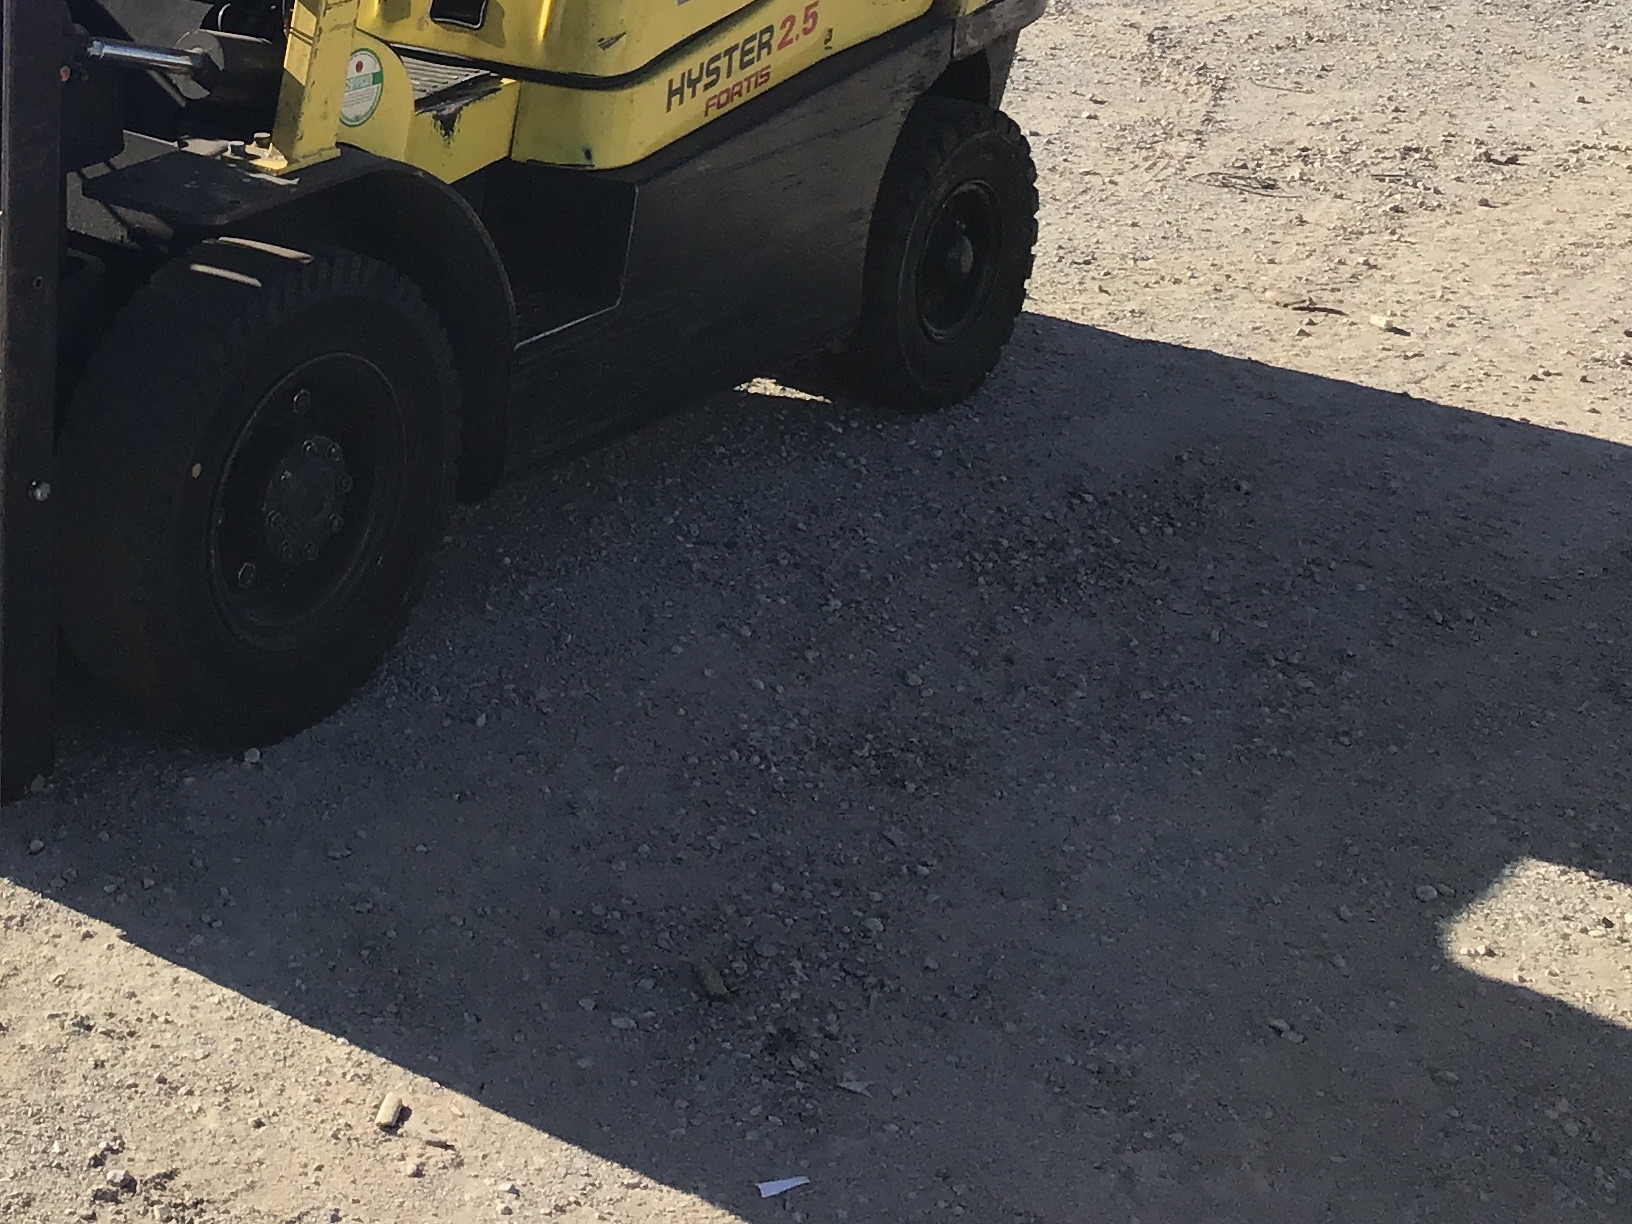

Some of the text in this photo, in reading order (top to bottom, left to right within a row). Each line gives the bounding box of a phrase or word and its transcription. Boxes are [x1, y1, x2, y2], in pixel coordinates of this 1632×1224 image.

[666, 0, 820, 114] HYSTER 2.5
[703, 64, 772, 118] FORTIS
